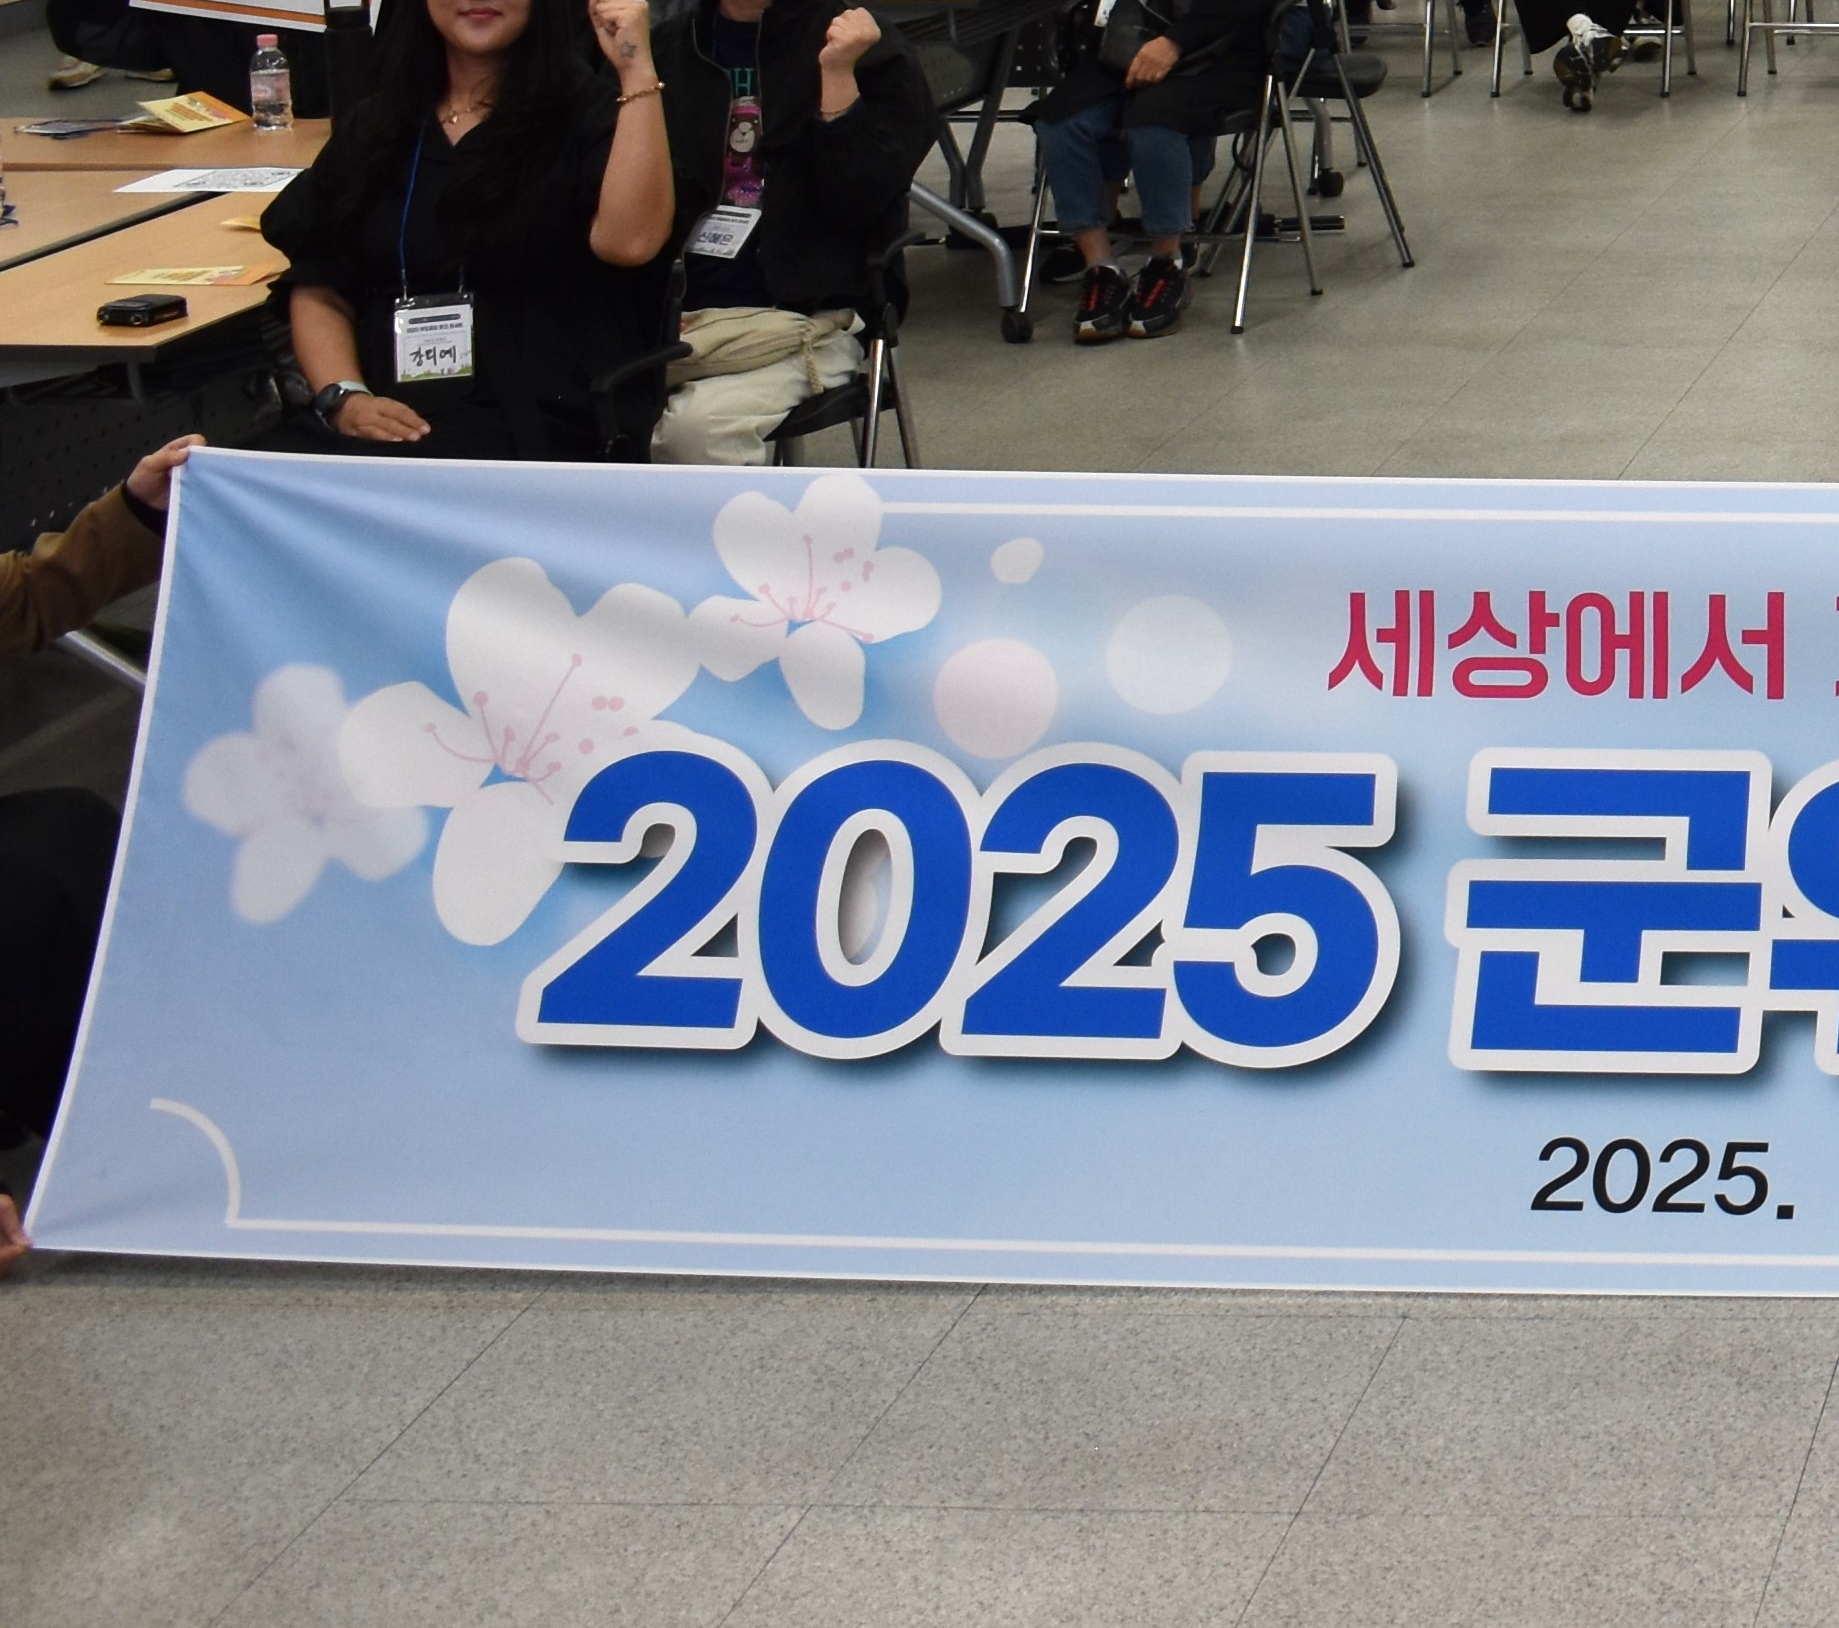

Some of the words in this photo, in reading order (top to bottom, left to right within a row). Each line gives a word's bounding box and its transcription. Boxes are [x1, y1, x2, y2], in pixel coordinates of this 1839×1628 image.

[1328, 590, 1785, 700] 세상에서
[530, 746, 1385, 1054] 2025
[1529, 1136, 1796, 1221] 2025.
